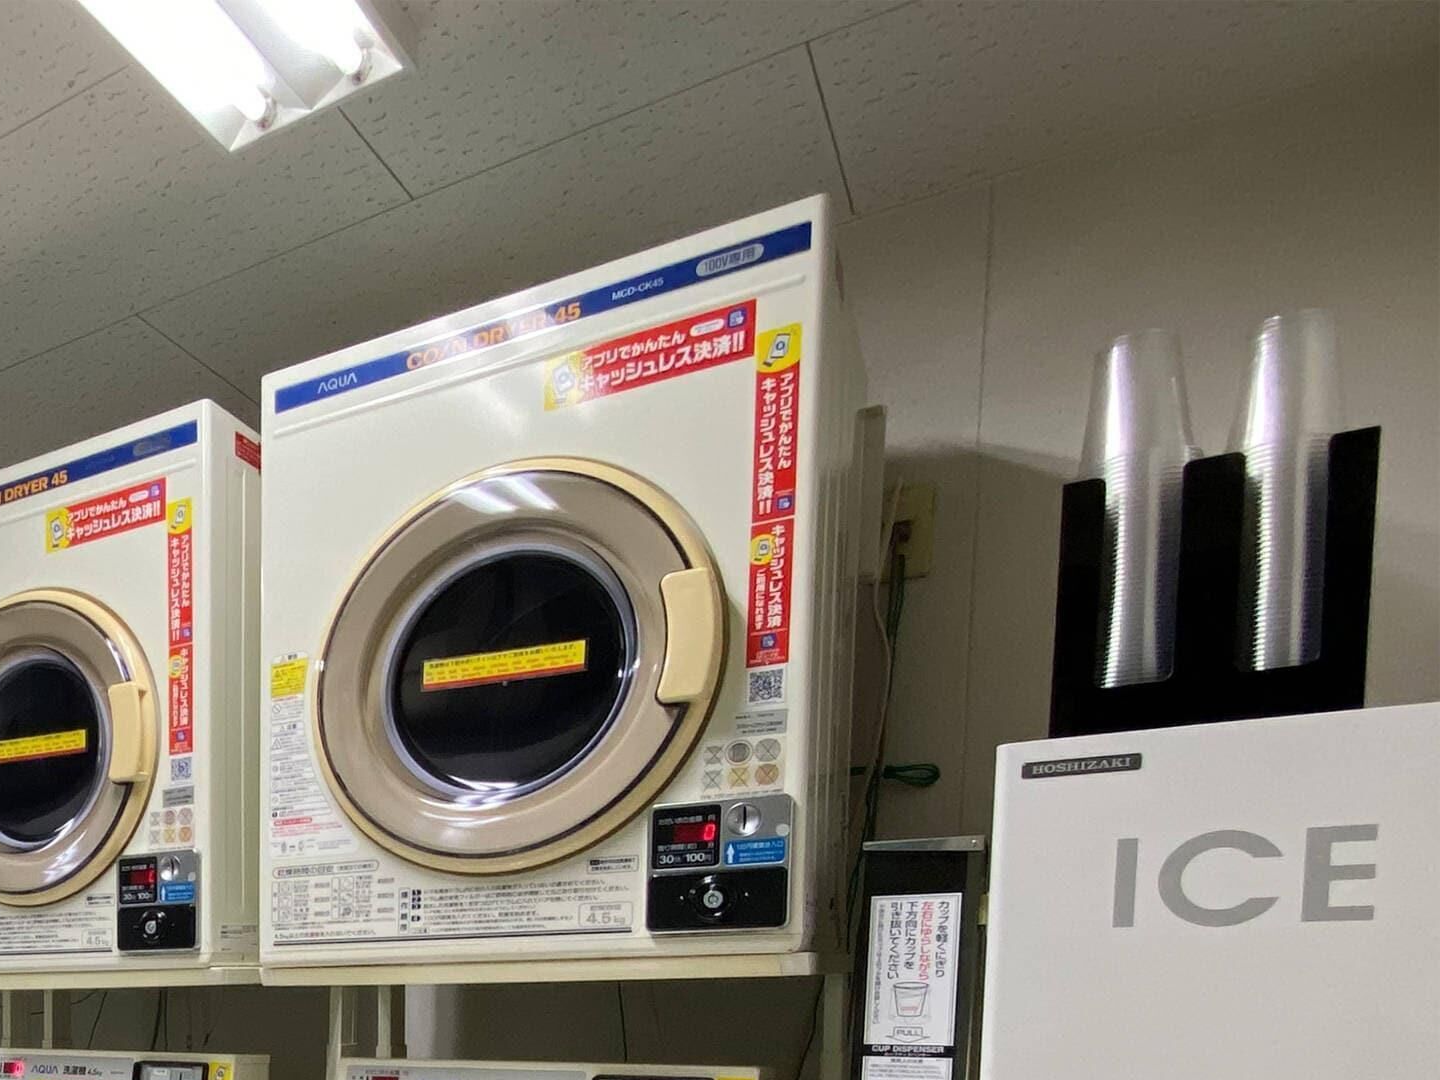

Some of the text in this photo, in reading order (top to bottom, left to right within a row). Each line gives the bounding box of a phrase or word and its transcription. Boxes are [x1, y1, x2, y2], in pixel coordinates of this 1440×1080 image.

[317, 372, 358, 394] AQUA
[554, 303, 581, 323] 45
[580, 329, 686, 370] アプリでかんたん
[777, 372, 794, 469] アプリでかんたん
[4, 476, 48, 503] DRYER
[51, 470, 68, 487] 45
[66, 497, 127, 524] アプリでかんたん
[1032, 756, 1132, 776] HOSHIZAKI
[704, 823, 716, 841] 0
[1112, 824, 1379, 928] ICE
[896, 1029, 920, 1037] PULL
[871, 1044, 945, 1054] CUP DISPENSER
[31, 1064, 59, 1074] AQUA
[62, 1065, 86, 1075] 洗濯機
